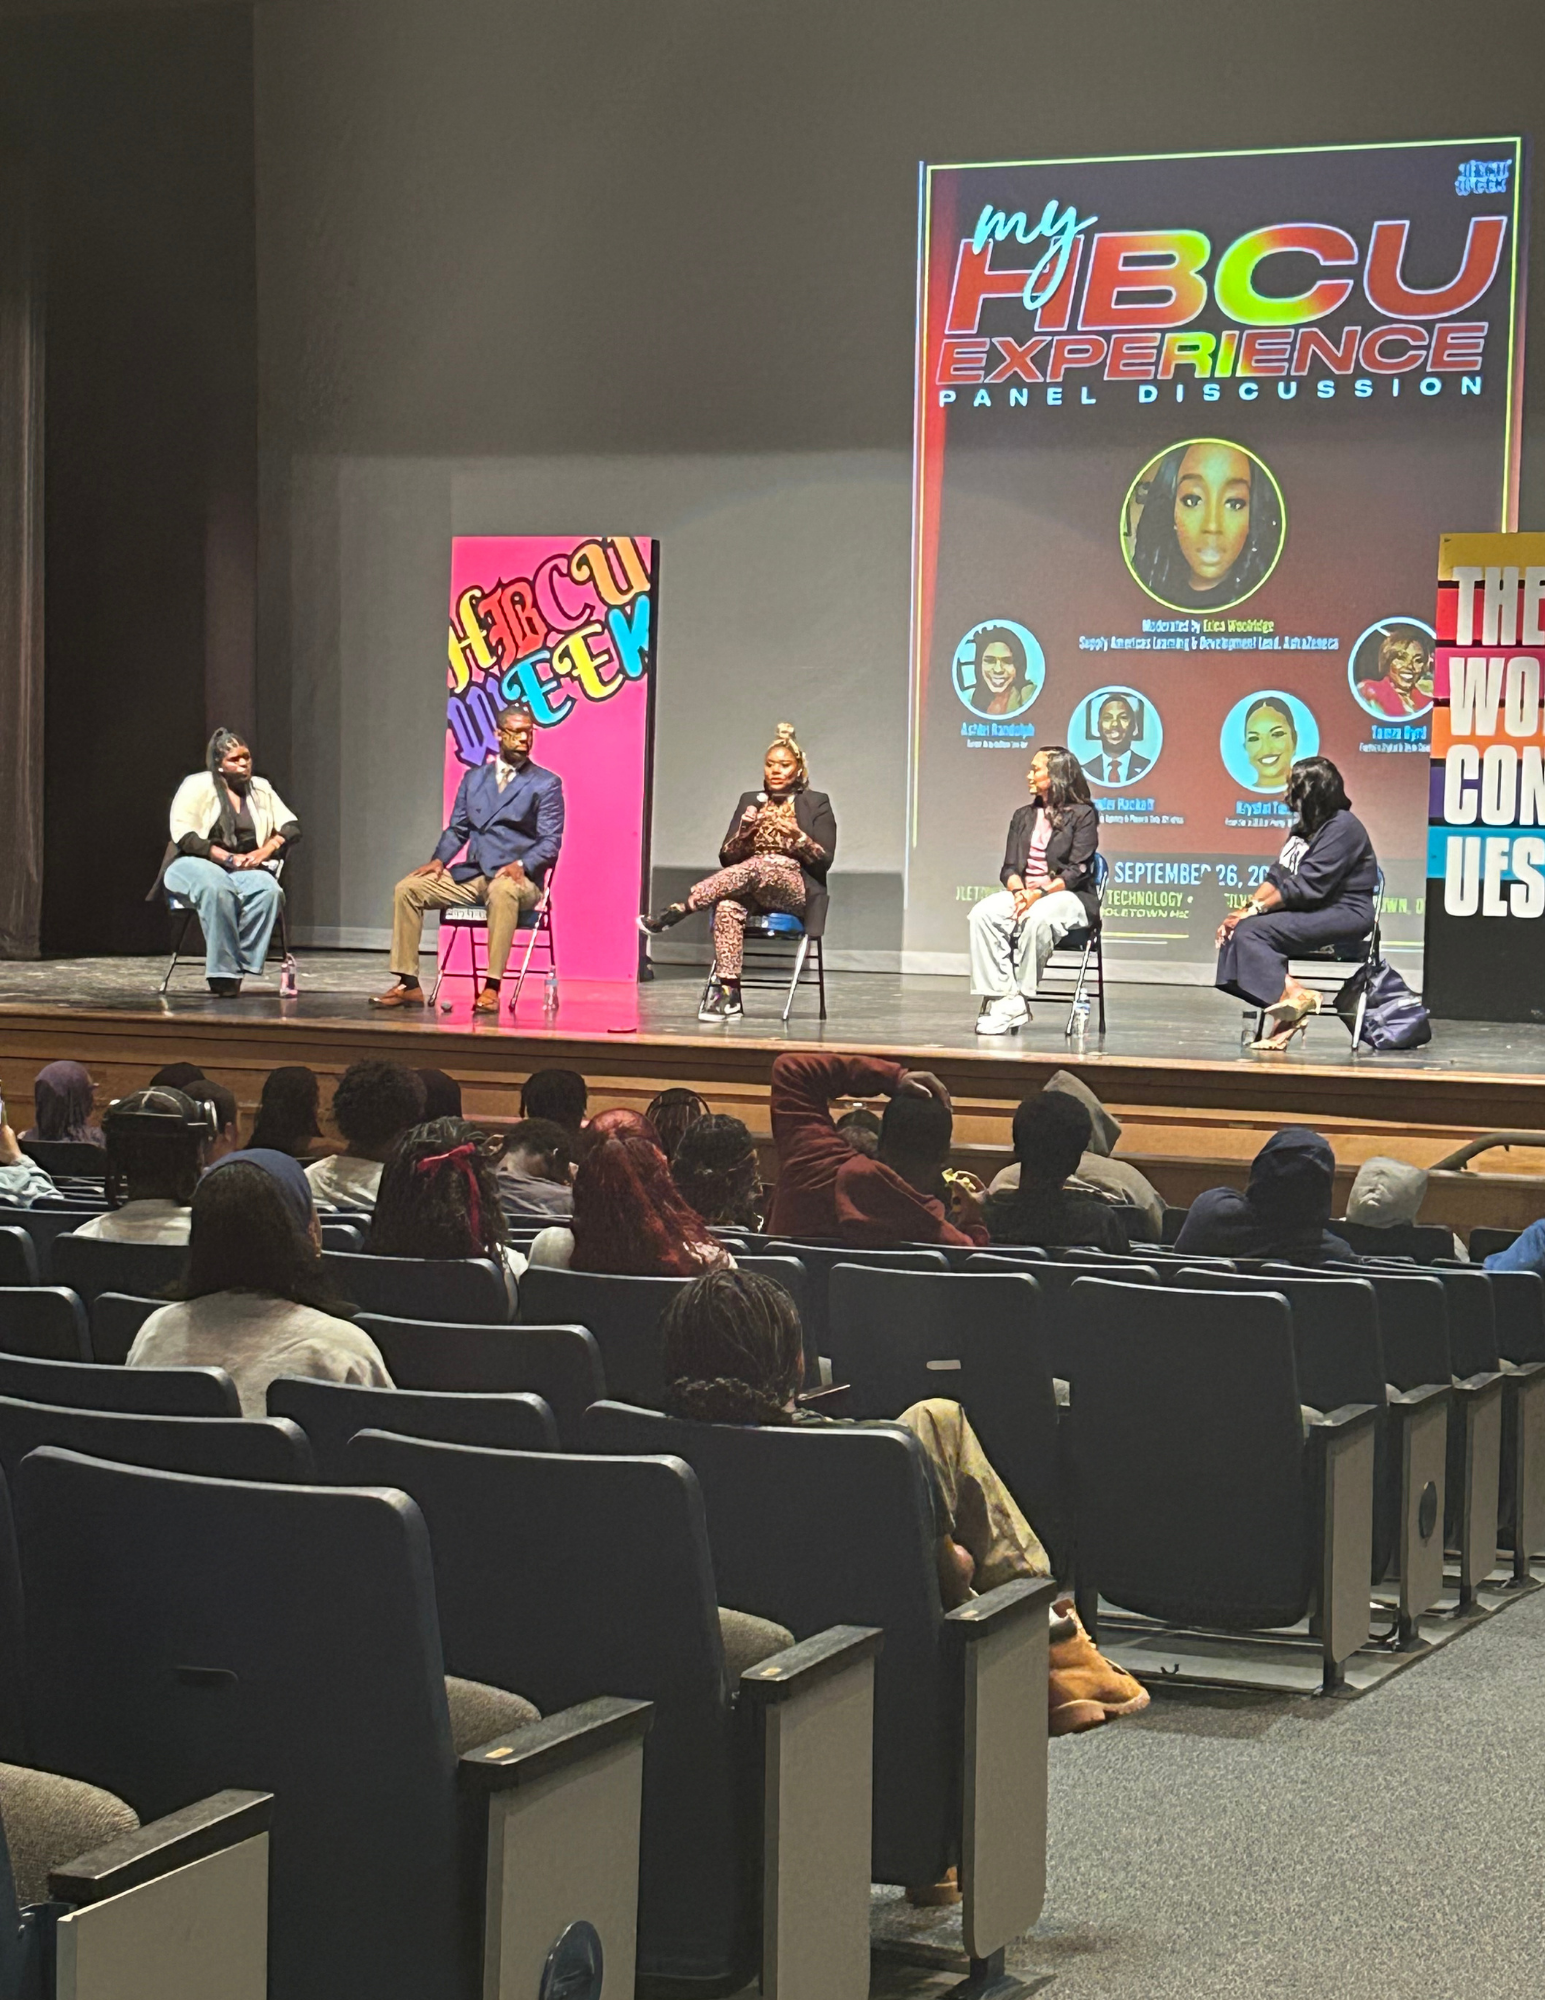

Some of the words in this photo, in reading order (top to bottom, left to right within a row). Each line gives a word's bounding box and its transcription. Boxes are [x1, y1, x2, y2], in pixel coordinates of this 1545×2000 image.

[944, 216, 1508, 334] HBCU
[972, 200, 1098, 311] my
[935, 322, 1488, 385] EXPERIENCE
[938, 389, 1097, 408] PANEL
[1138, 376, 1483, 403] DISCUSSION
[447, 537, 651, 694] HBCU
[1452, 566, 1545, 646] THE
[1449, 656, 1545, 737] WO
[1106, 889, 1183, 907] TECHNOLOGY
[1215, 863, 1243, 889] 26,
